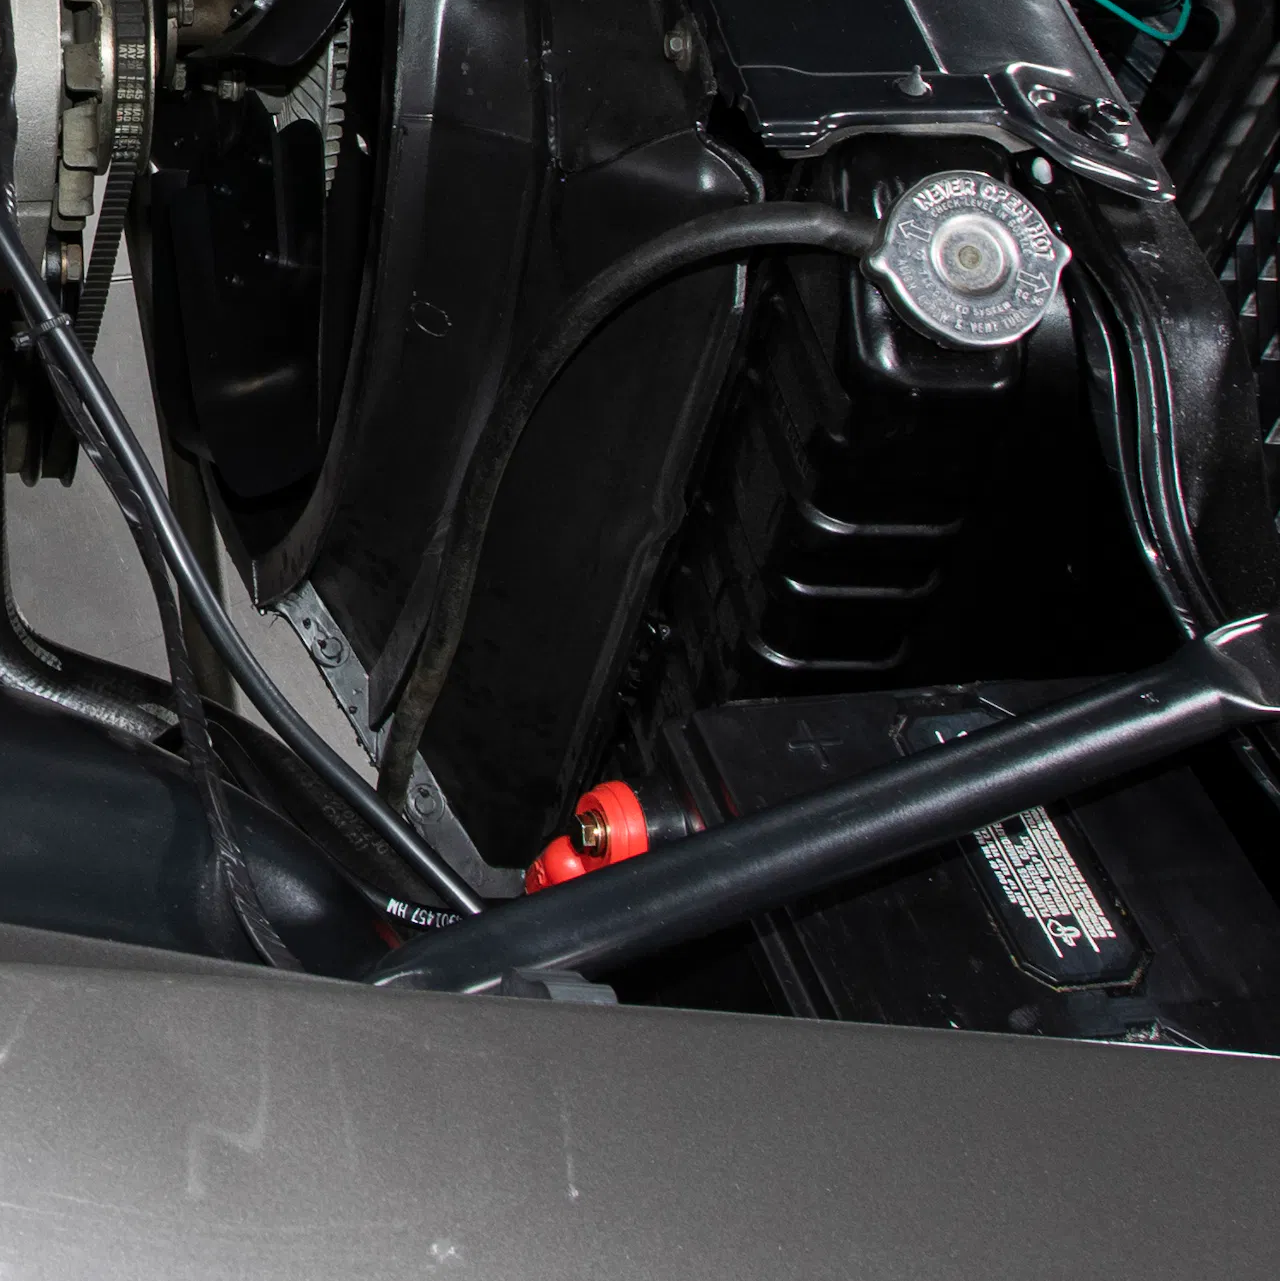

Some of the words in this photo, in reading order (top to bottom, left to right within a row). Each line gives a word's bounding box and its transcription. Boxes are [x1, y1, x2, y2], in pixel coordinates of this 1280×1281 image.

[912, 177, 977, 212] NEVER
[980, 182, 1034, 223] OPEN
[1023, 220, 1056, 261] HOT
[930, 199, 961, 218] CHECK
[964, 199, 994, 214] LEVEL
[996, 209, 1009, 220] IN
[1013, 843, 1030, 859] GET
[1018, 835, 1038, 854] FAST
[1030, 856, 1051, 878] HELP
[1015, 868, 1036, 889] EYES
[1027, 889, 1052, 917] FLUSH
[1040, 893, 1061, 915] WITH
[1042, 879, 1071, 915] MEDICAL
